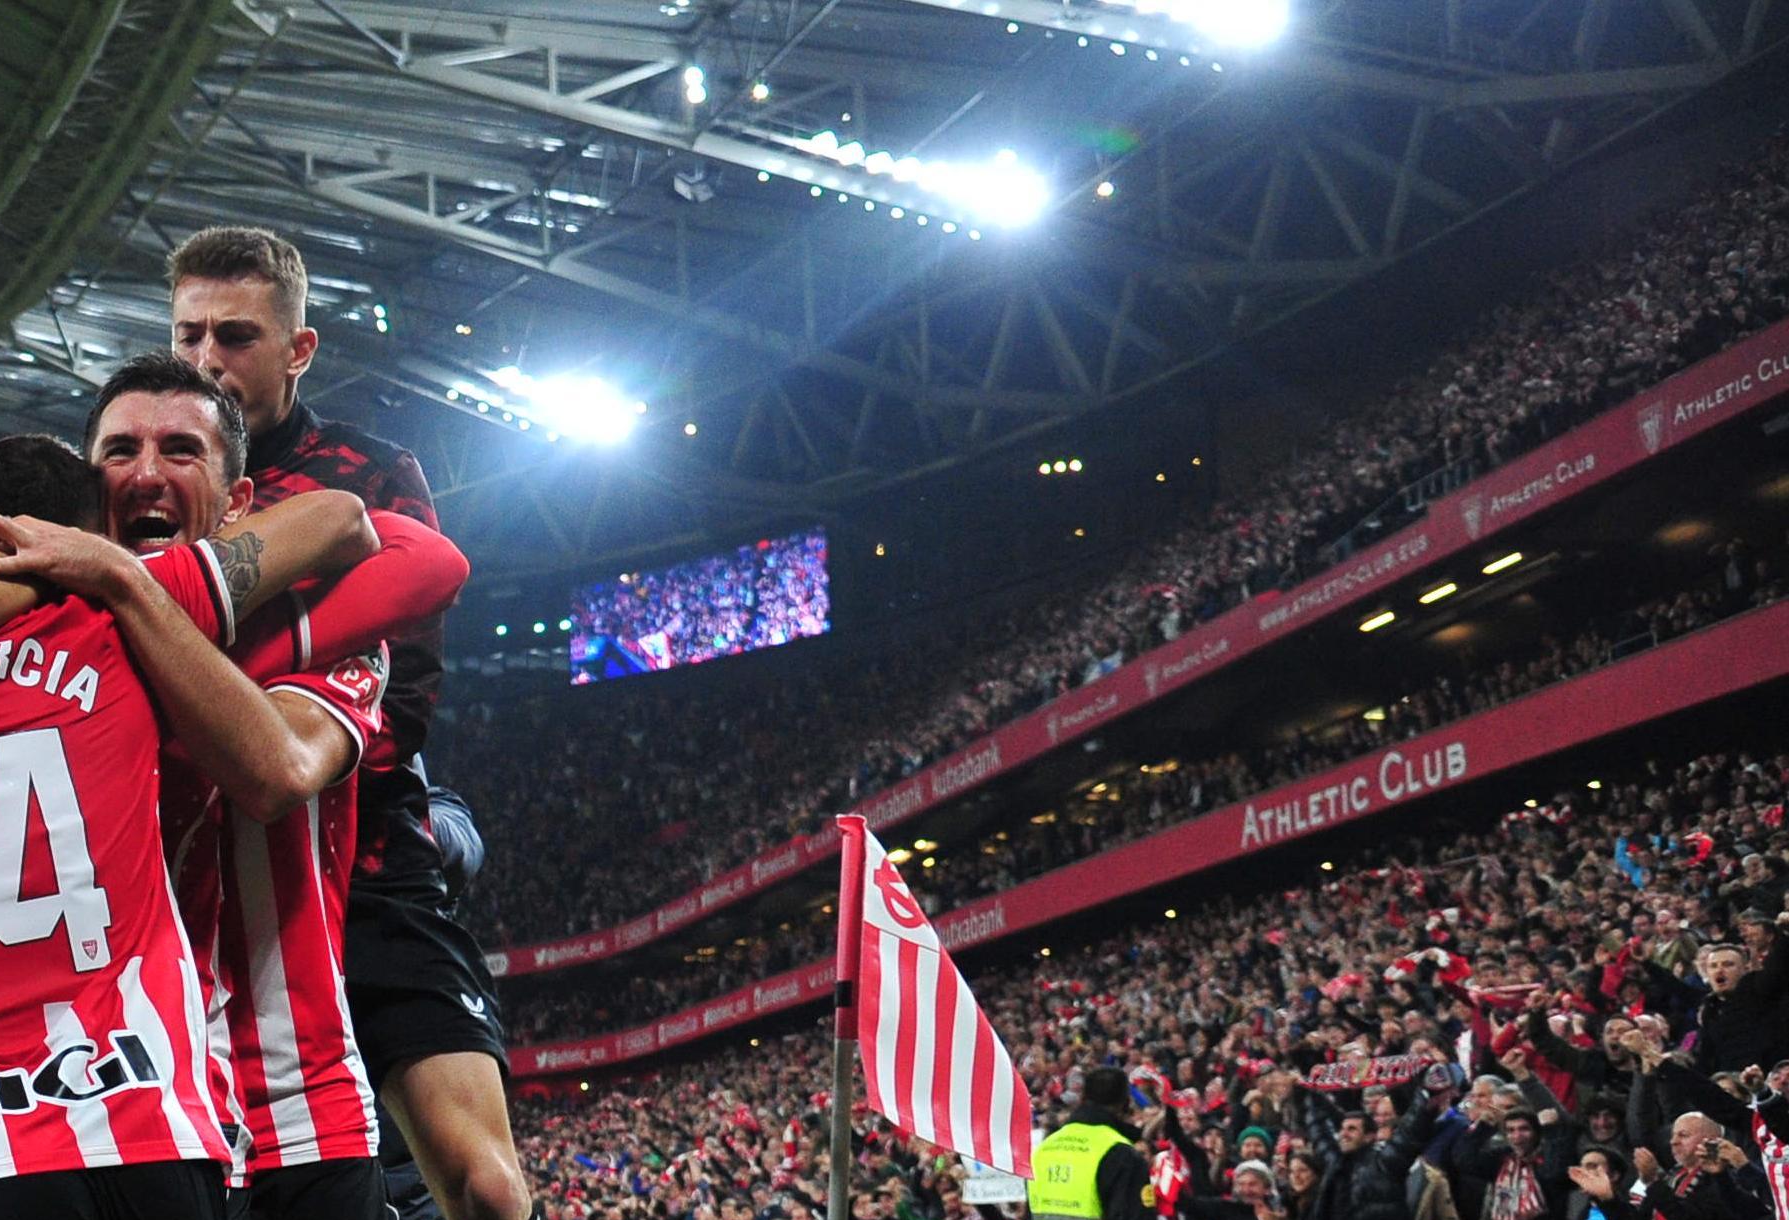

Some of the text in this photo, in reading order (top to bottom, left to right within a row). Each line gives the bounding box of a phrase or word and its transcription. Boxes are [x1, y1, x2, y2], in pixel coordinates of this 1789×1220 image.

[1673, 374, 1753, 426] ATHLETIC
[1240, 742, 1468, 850] ATHLETIC CLUB
